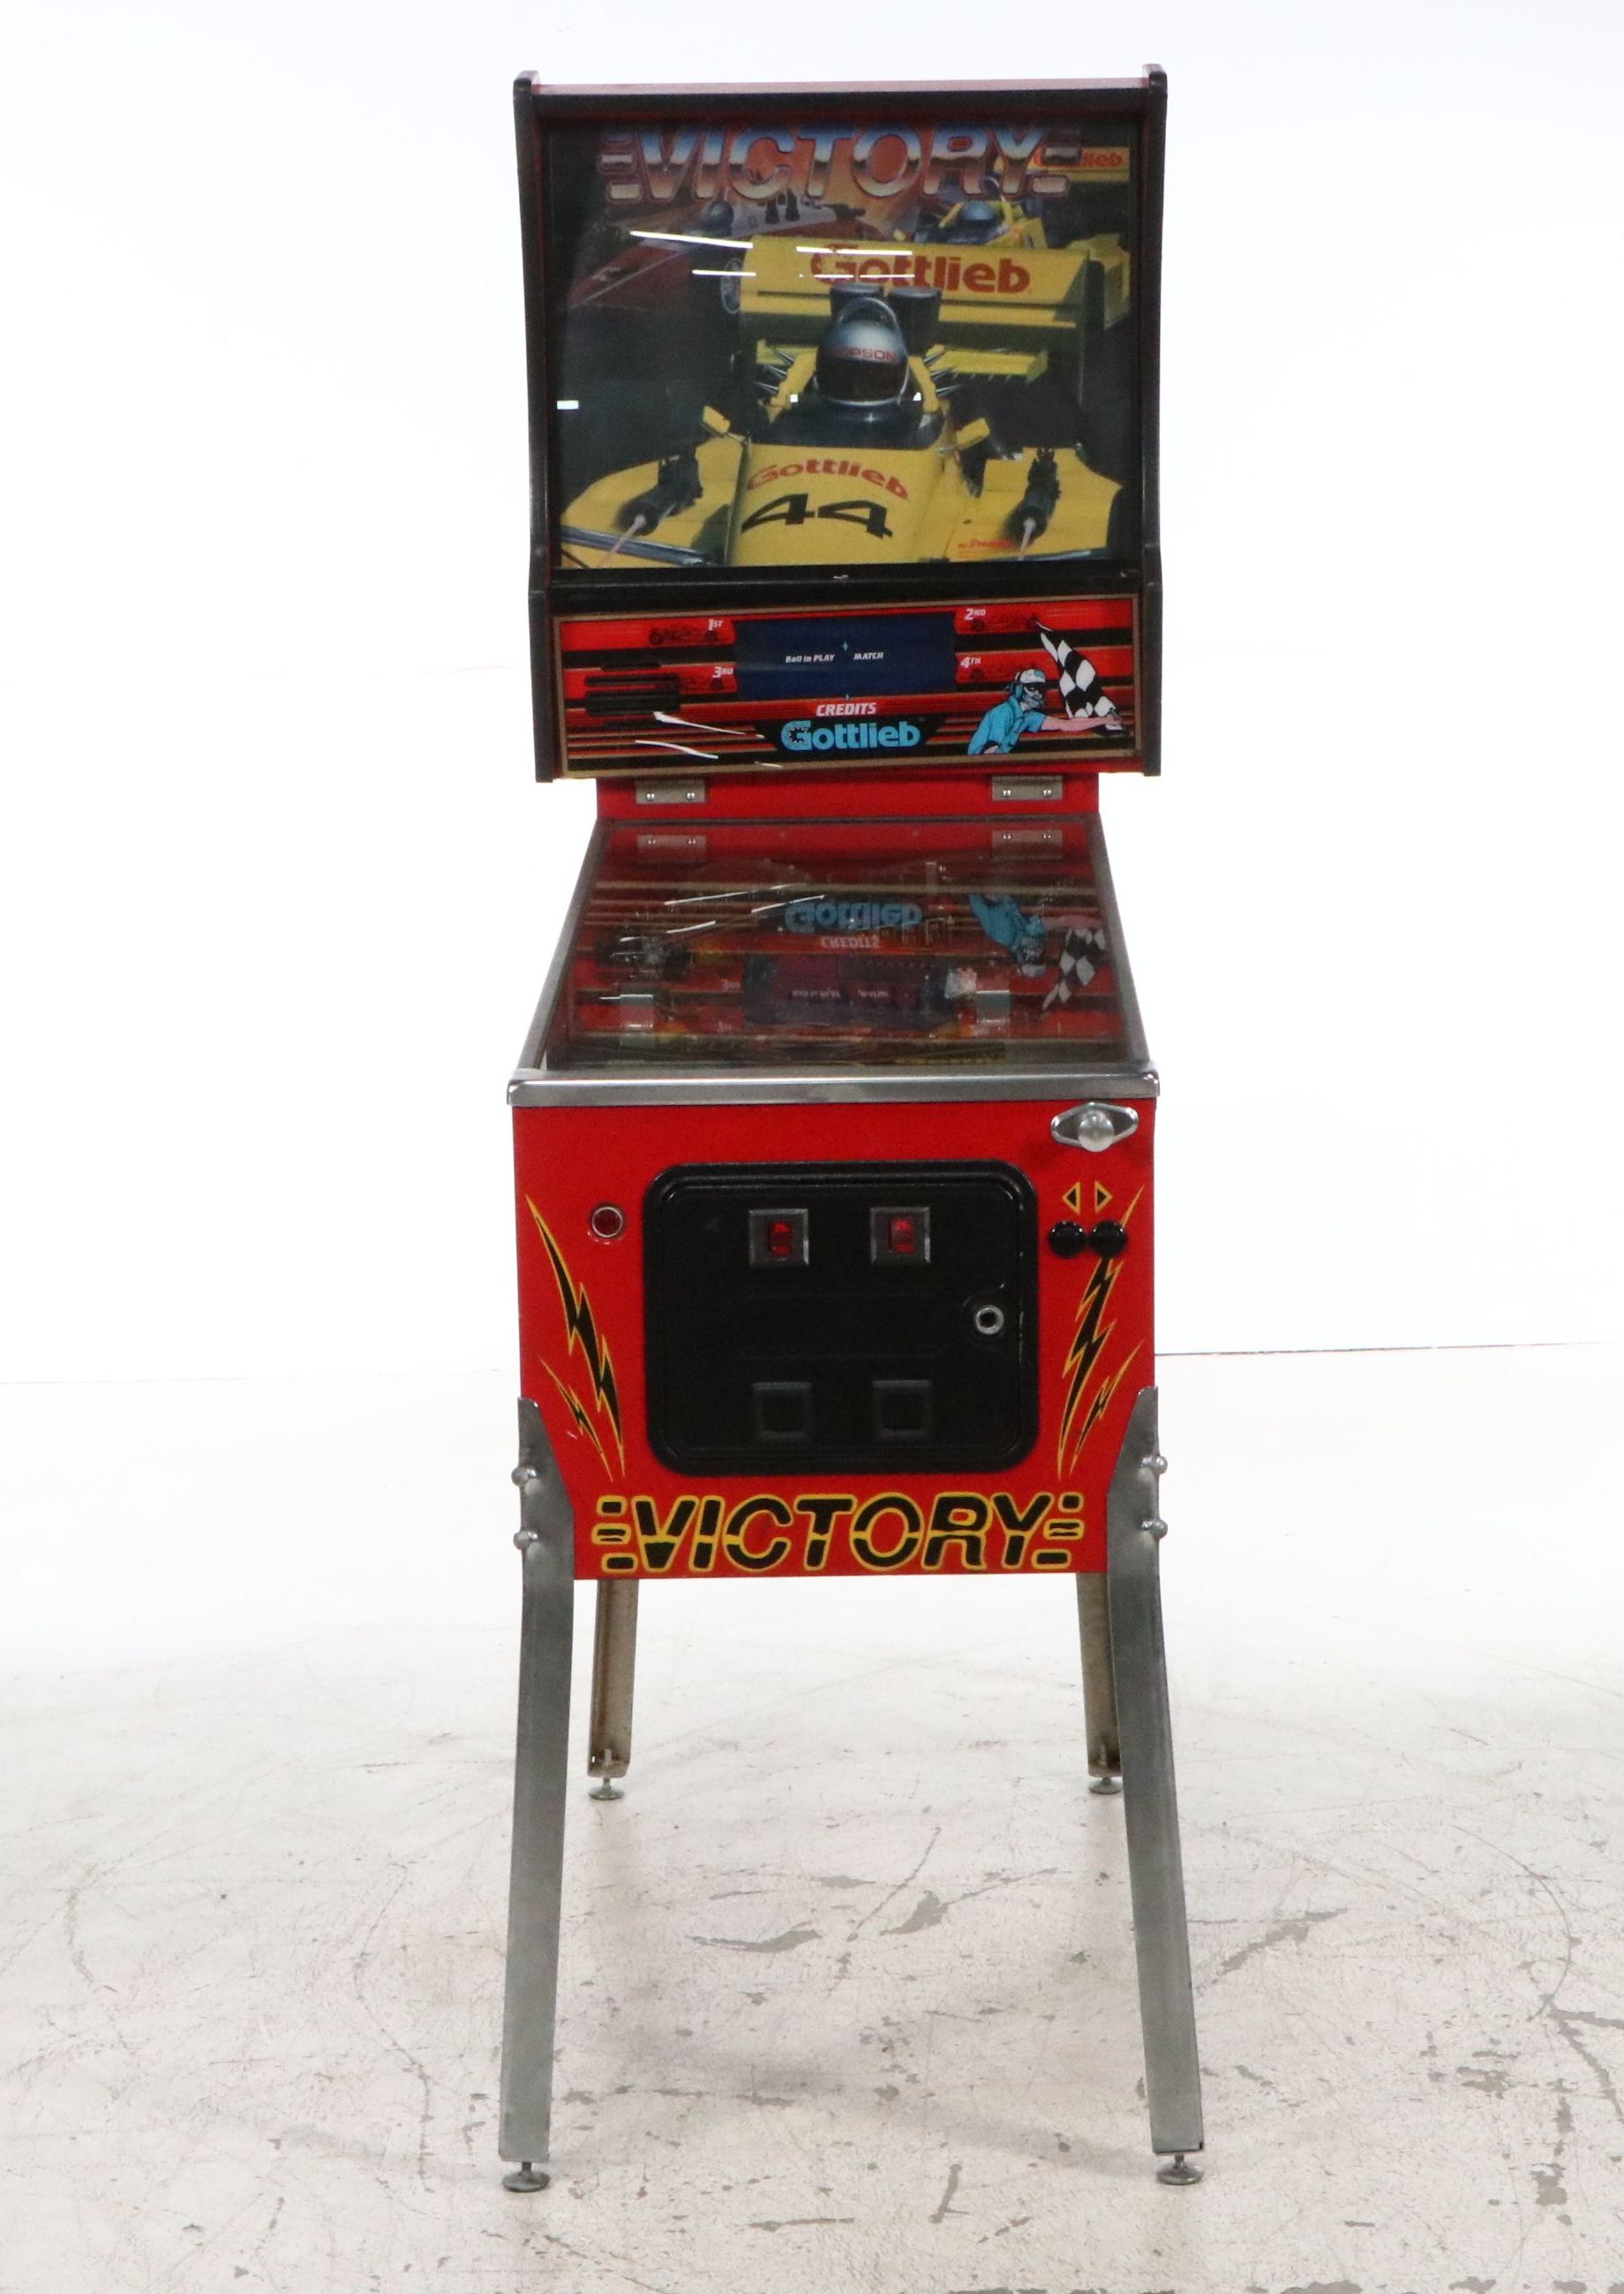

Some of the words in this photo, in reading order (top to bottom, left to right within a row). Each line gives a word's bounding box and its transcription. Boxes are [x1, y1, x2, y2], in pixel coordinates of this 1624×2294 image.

[633, 123, 1050, 199] VICTORY
[809, 243, 1031, 294] Gottlieb
[747, 458, 908, 500] Gottlieb
[741, 493, 893, 540] 44
[708, 619, 723, 631] 1ST
[965, 607, 987, 621] 2ND
[712, 666, 734, 679] 3RD
[960, 656, 981, 668] 4TH
[816, 702, 877, 718] CREDITS
[781, 719, 921, 751] Gottlieb
[631, 1492, 1053, 1572] VICTORY
